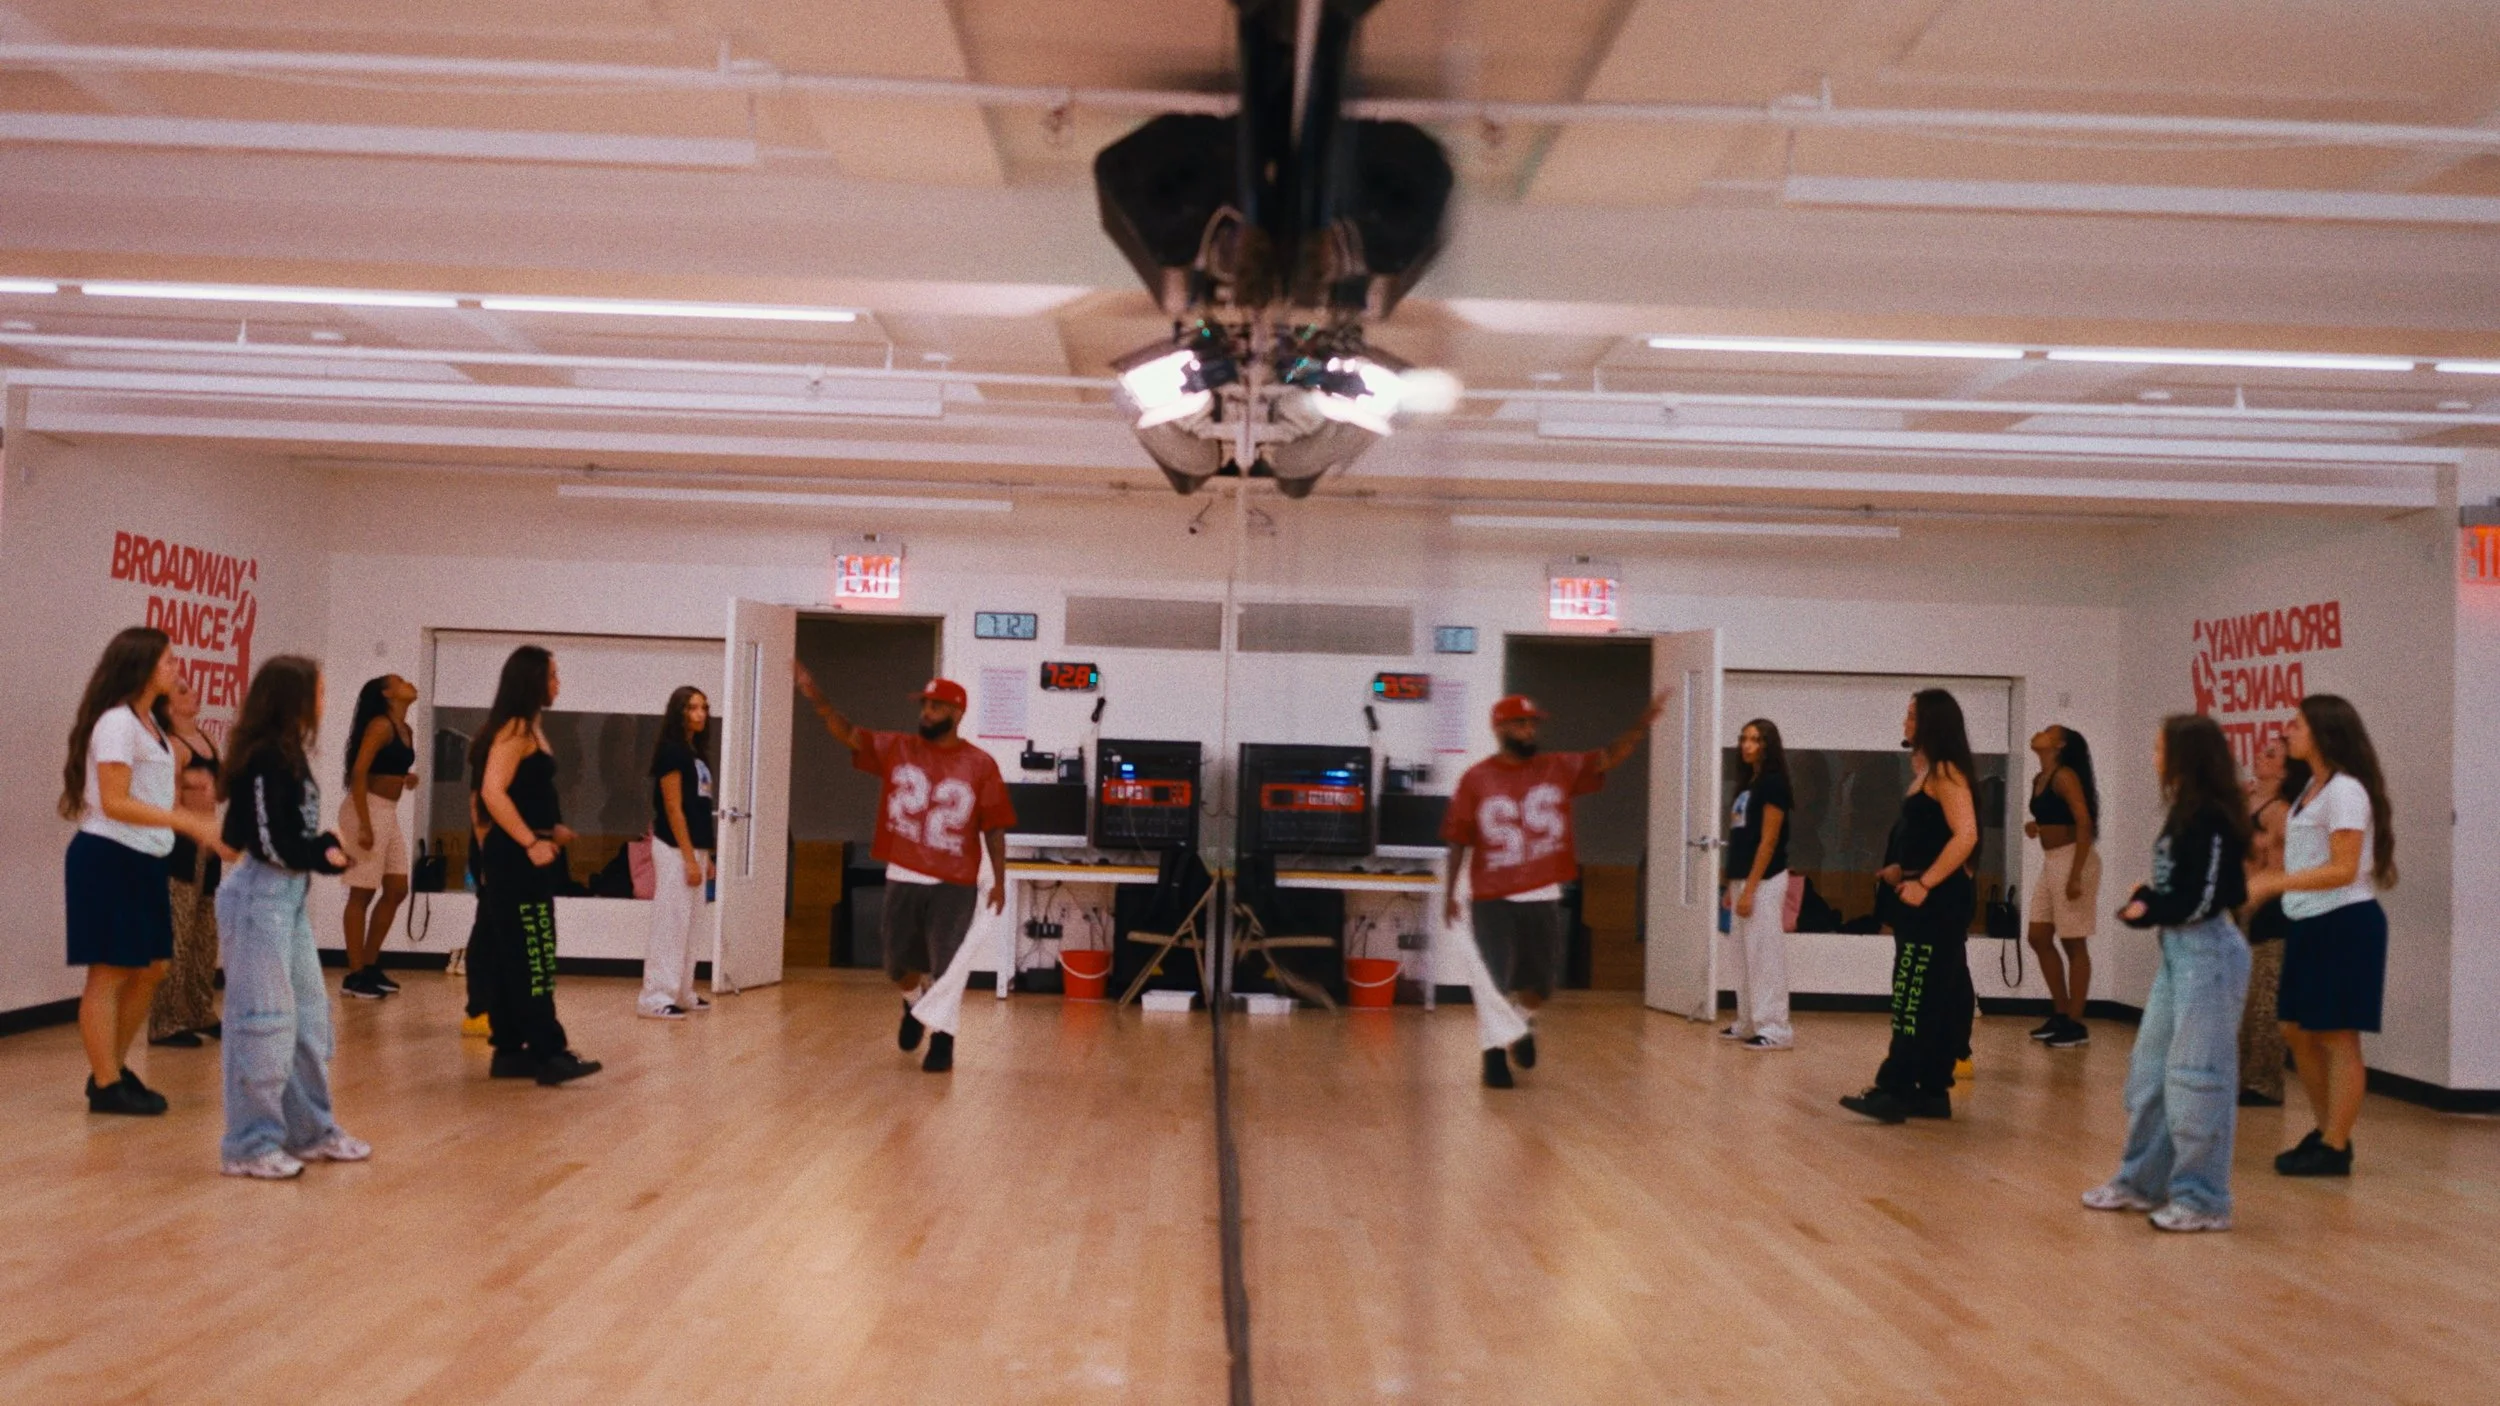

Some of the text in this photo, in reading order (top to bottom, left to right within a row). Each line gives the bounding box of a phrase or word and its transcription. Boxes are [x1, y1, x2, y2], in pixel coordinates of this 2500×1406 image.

[111, 530, 247, 601] BROADWAY
[845, 555, 893, 594] EXIT
[145, 595, 229, 652] DANCE
[173, 655, 238, 707] NTER
[887, 763, 977, 856] 22
[537, 903, 557, 991] MOVEMT
